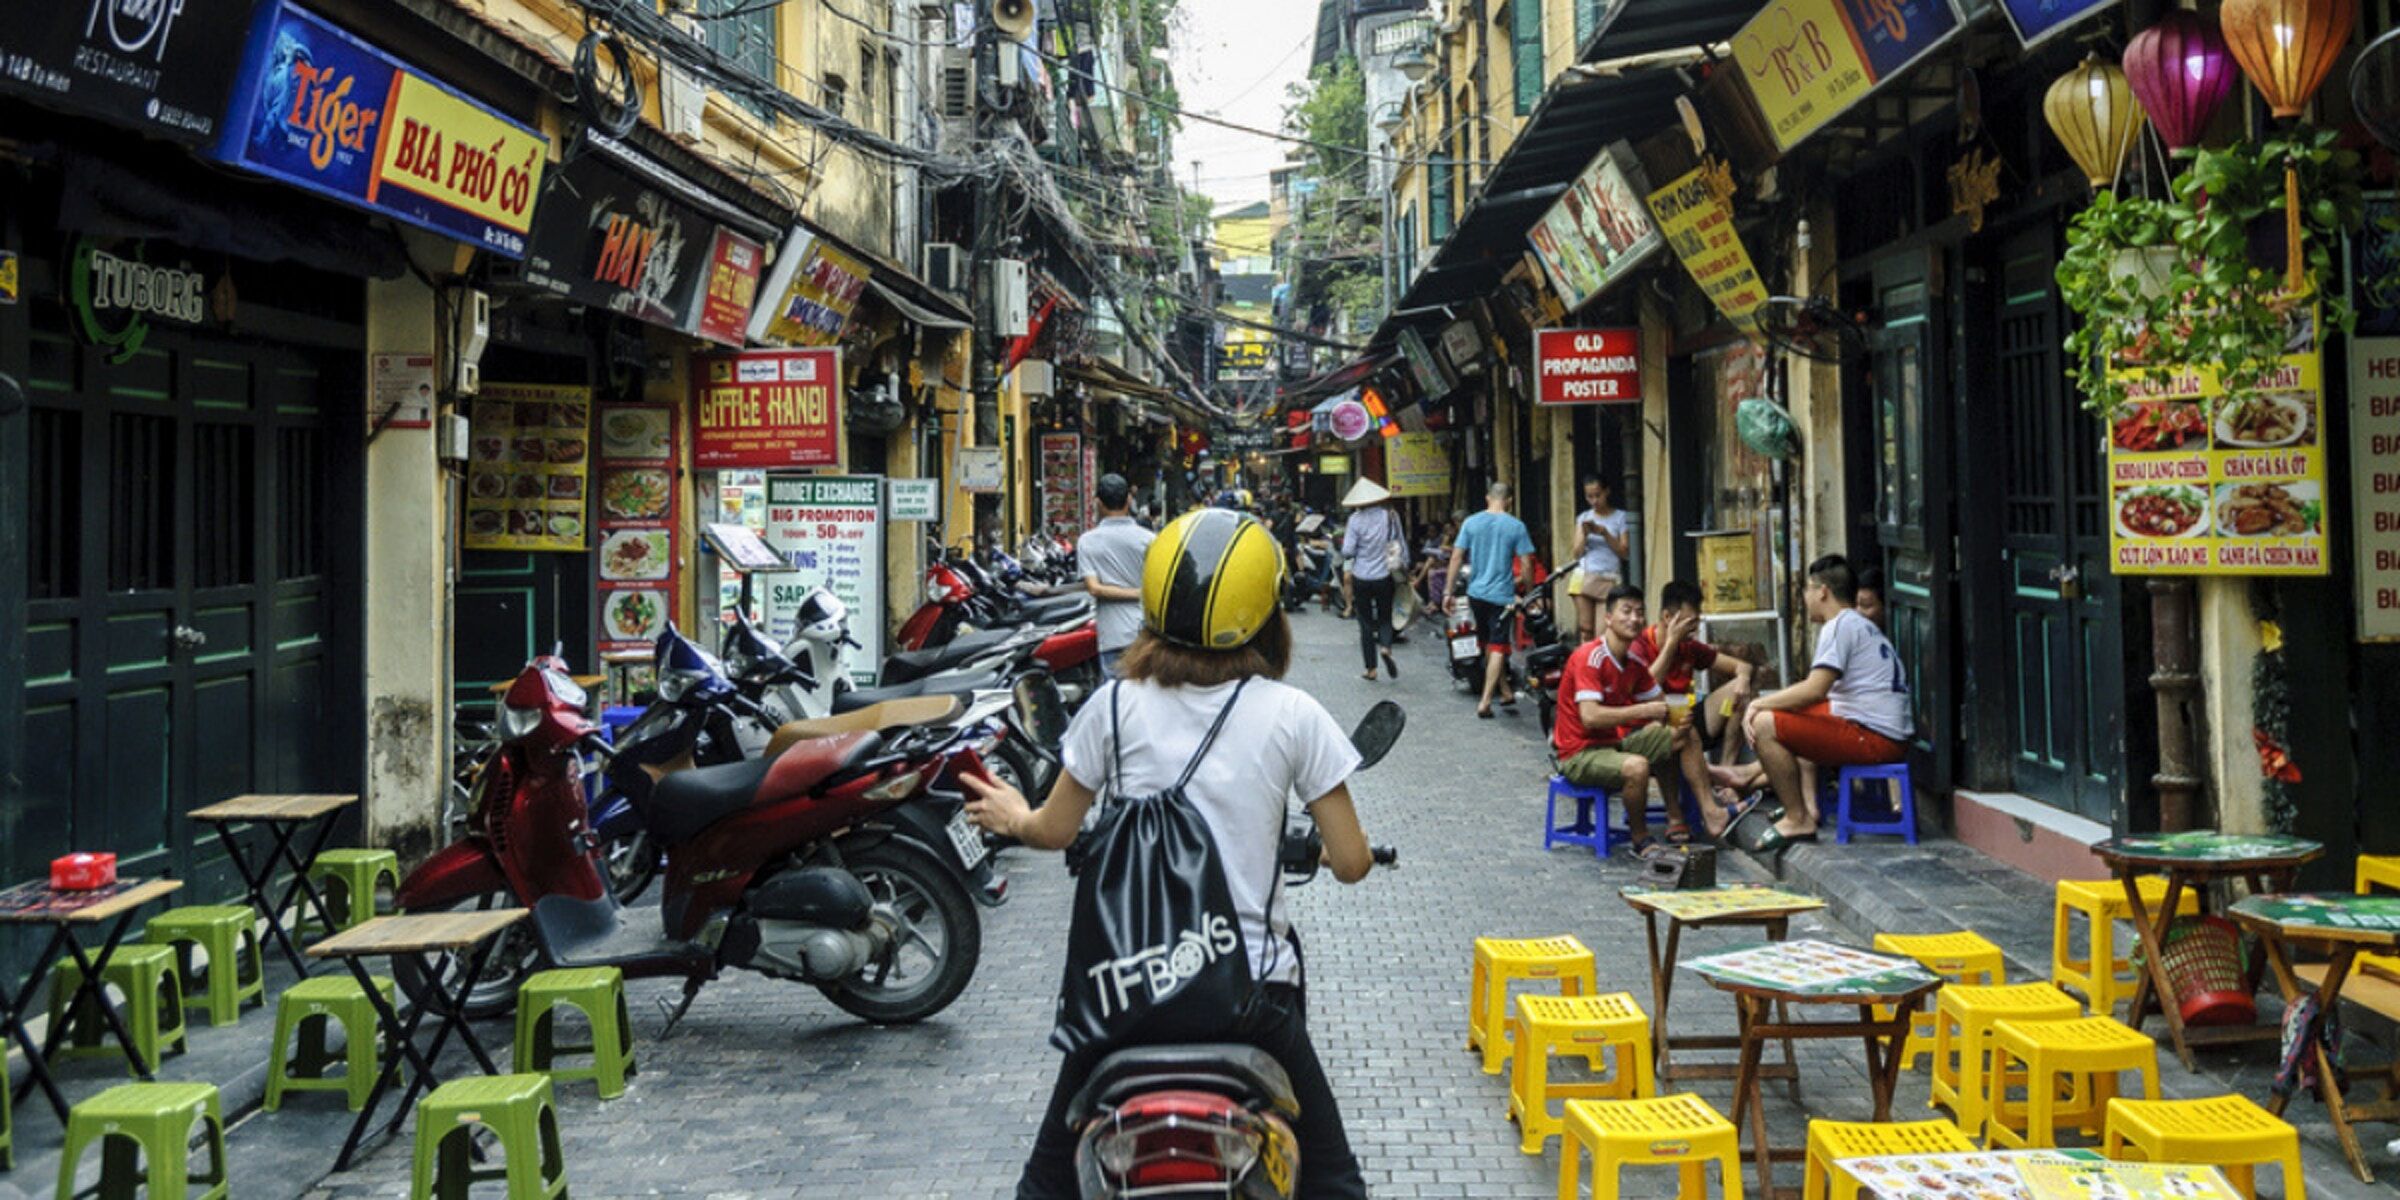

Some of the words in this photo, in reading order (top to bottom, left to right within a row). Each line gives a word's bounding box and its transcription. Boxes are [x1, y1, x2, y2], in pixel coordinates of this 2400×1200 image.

[74, 45, 160, 91] RESTAURANT
[1771, 47, 1800, 96] B
[1801, 19, 1832, 72] B
[288, 60, 377, 171] Tiger
[395, 116, 443, 185] BIA
[446, 135, 506, 204] PHỐ
[501, 146, 536, 217] CỔ
[594, 212, 659, 290] HAY
[92, 249, 203, 324] TUBORG
[1574, 334, 1604, 352] OLD
[1543, 355, 1637, 376] PROPAGANDA
[1563, 379, 1618, 398] POSTER
[700, 387, 762, 427] LITTLE
[768, 386, 828, 426] HANOI
[772, 481, 813, 502] MONEY
[815, 481, 875, 502] EXCHANGE
[772, 508, 794, 522] BIG
[798, 508, 875, 523] PROMOTION
[2375, 512, 2400, 532] BI
[2376, 551, 2400, 571] BI
[2377, 590, 2400, 610] BI
[1088, 911, 1237, 1018] TFBOYS
